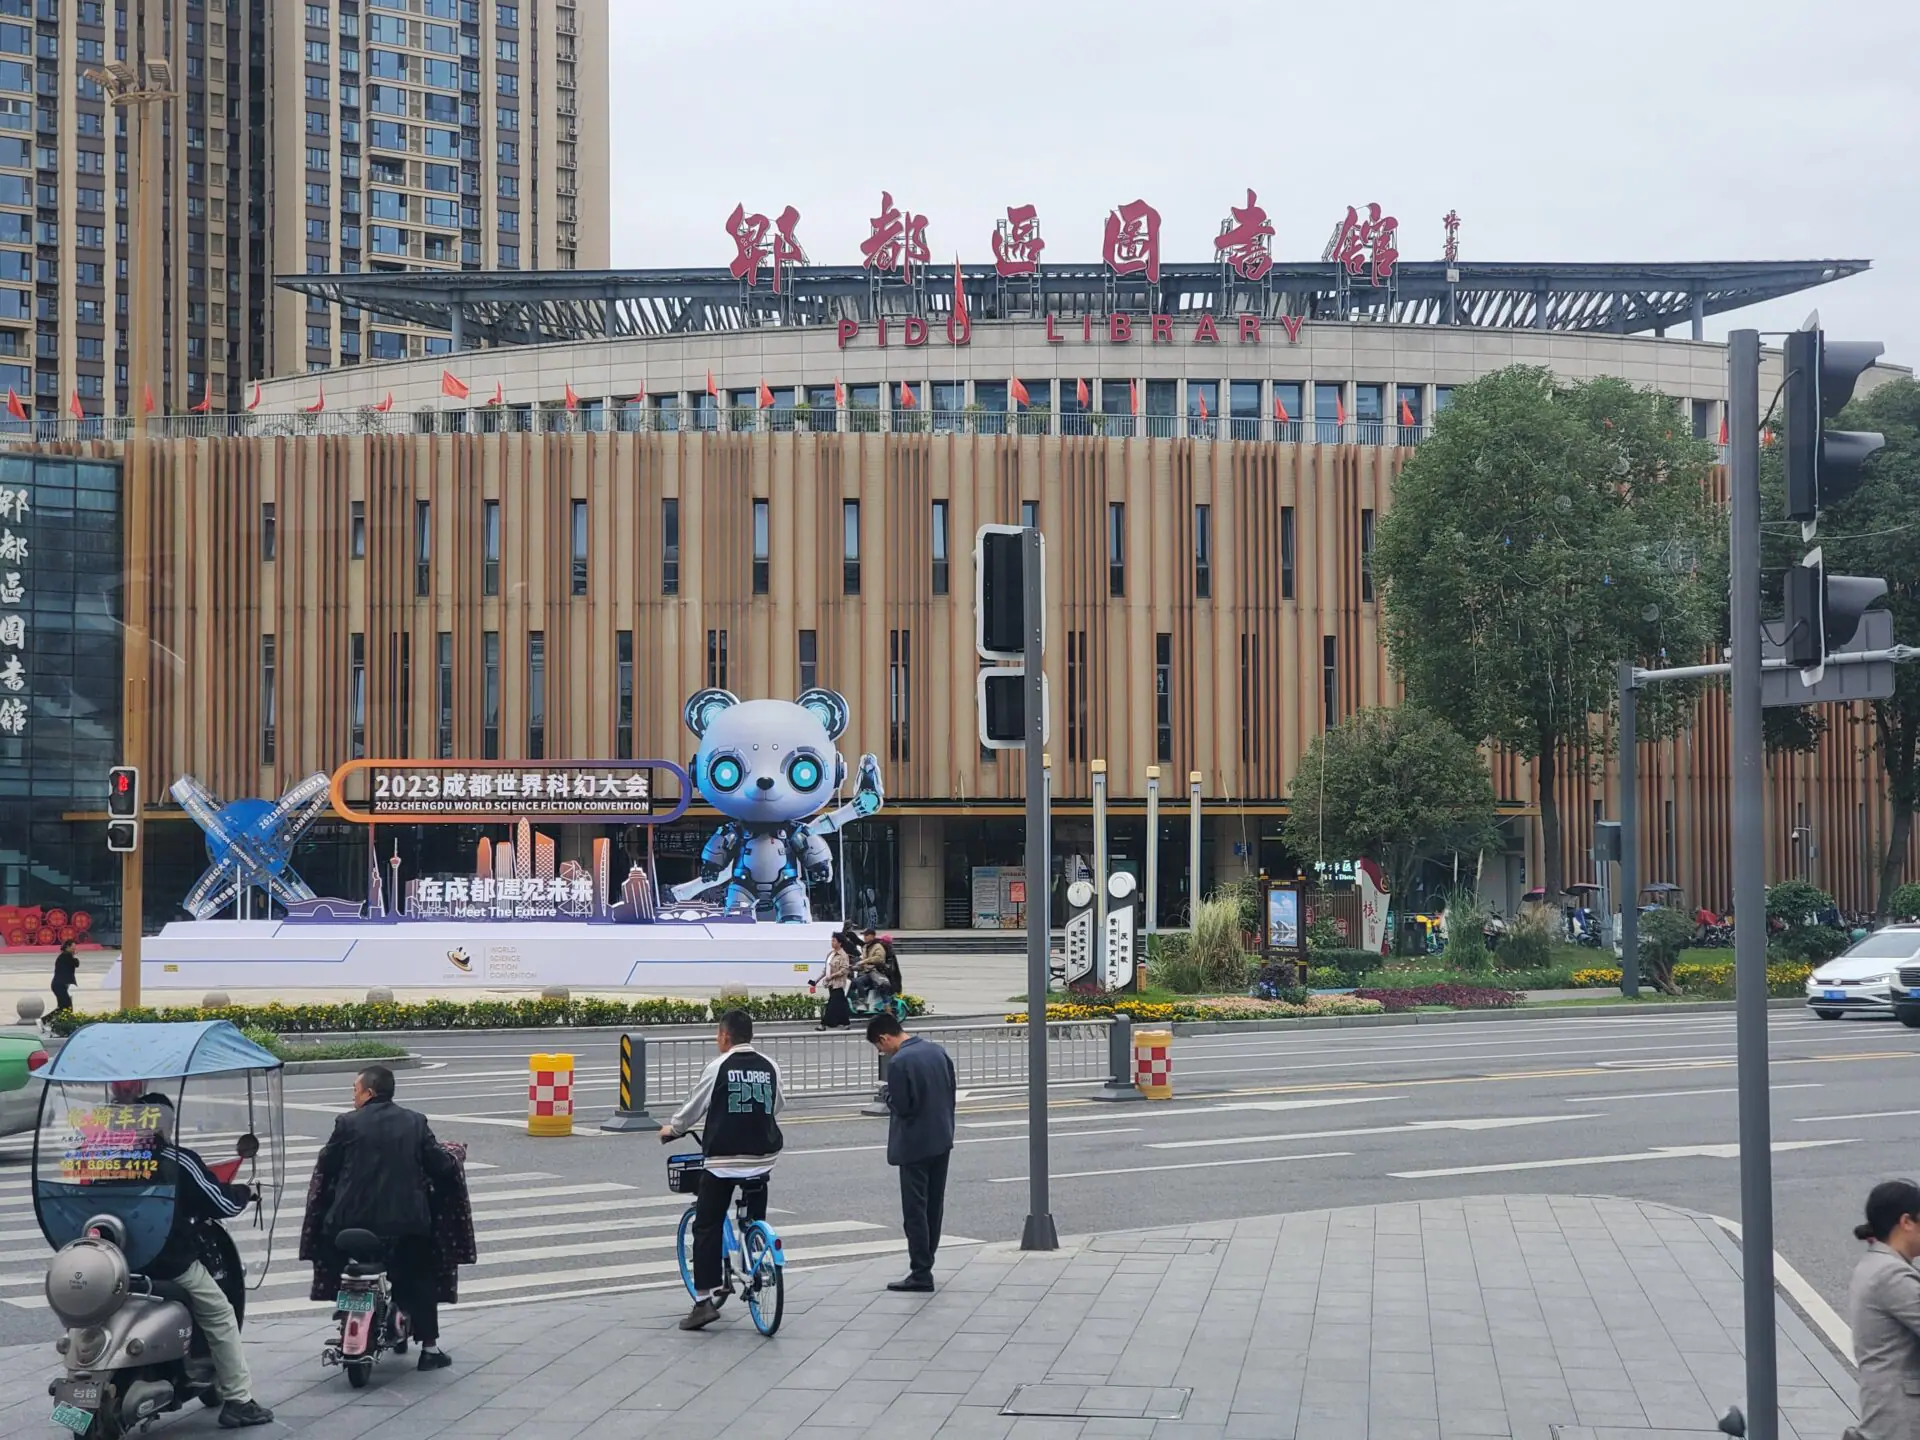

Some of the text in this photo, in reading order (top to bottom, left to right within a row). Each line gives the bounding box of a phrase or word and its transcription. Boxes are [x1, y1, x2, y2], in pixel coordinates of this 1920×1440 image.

[838, 313, 1304, 349] PIDU LIBRARY
[375, 774, 649, 798] 2023成都世界科幻大会
[375, 801, 649, 811] 2023 CHENGDU WORLD SCIENCE FICTION CONVENTION
[418, 877, 593, 902] 在成都遇见未来
[455, 907, 557, 917] Meet The Future
[728, 1082, 772, 1114] 24
[125, 1160, 158, 1170] 4112
